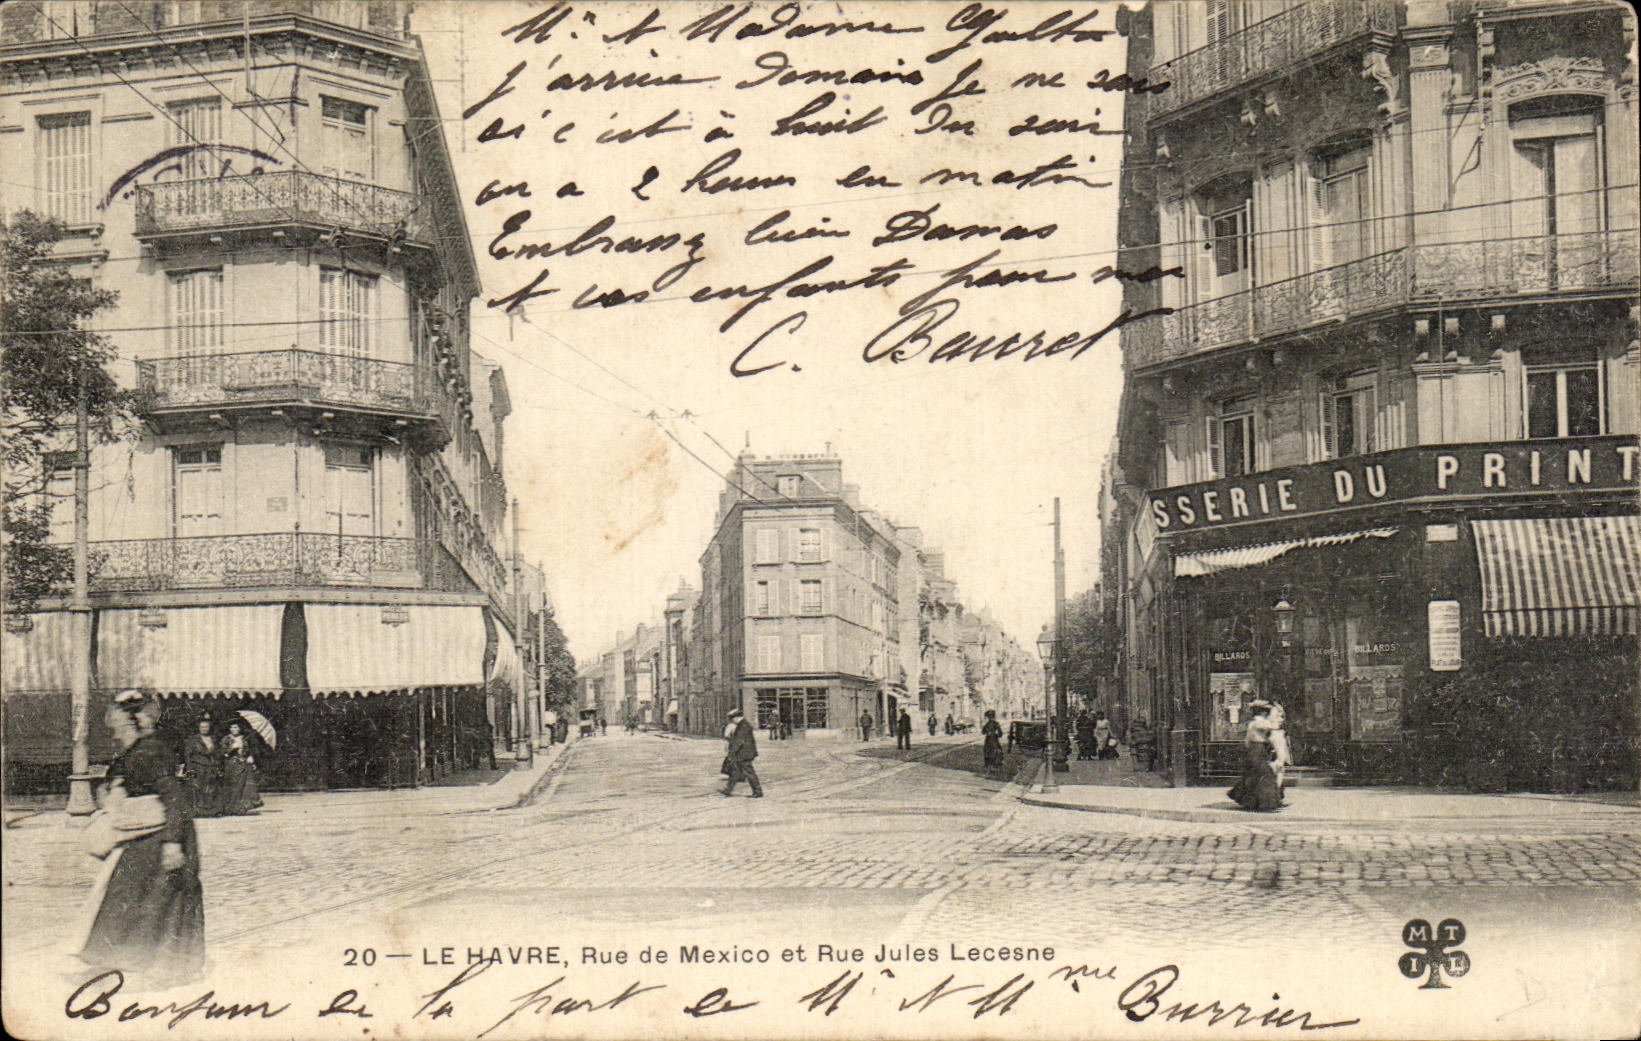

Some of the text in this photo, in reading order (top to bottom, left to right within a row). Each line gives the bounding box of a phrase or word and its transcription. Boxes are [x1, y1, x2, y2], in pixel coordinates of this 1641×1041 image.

[631, 165, 659, 201] 2
[1153, 446, 1641, 529] SSERIE DU PRINT
